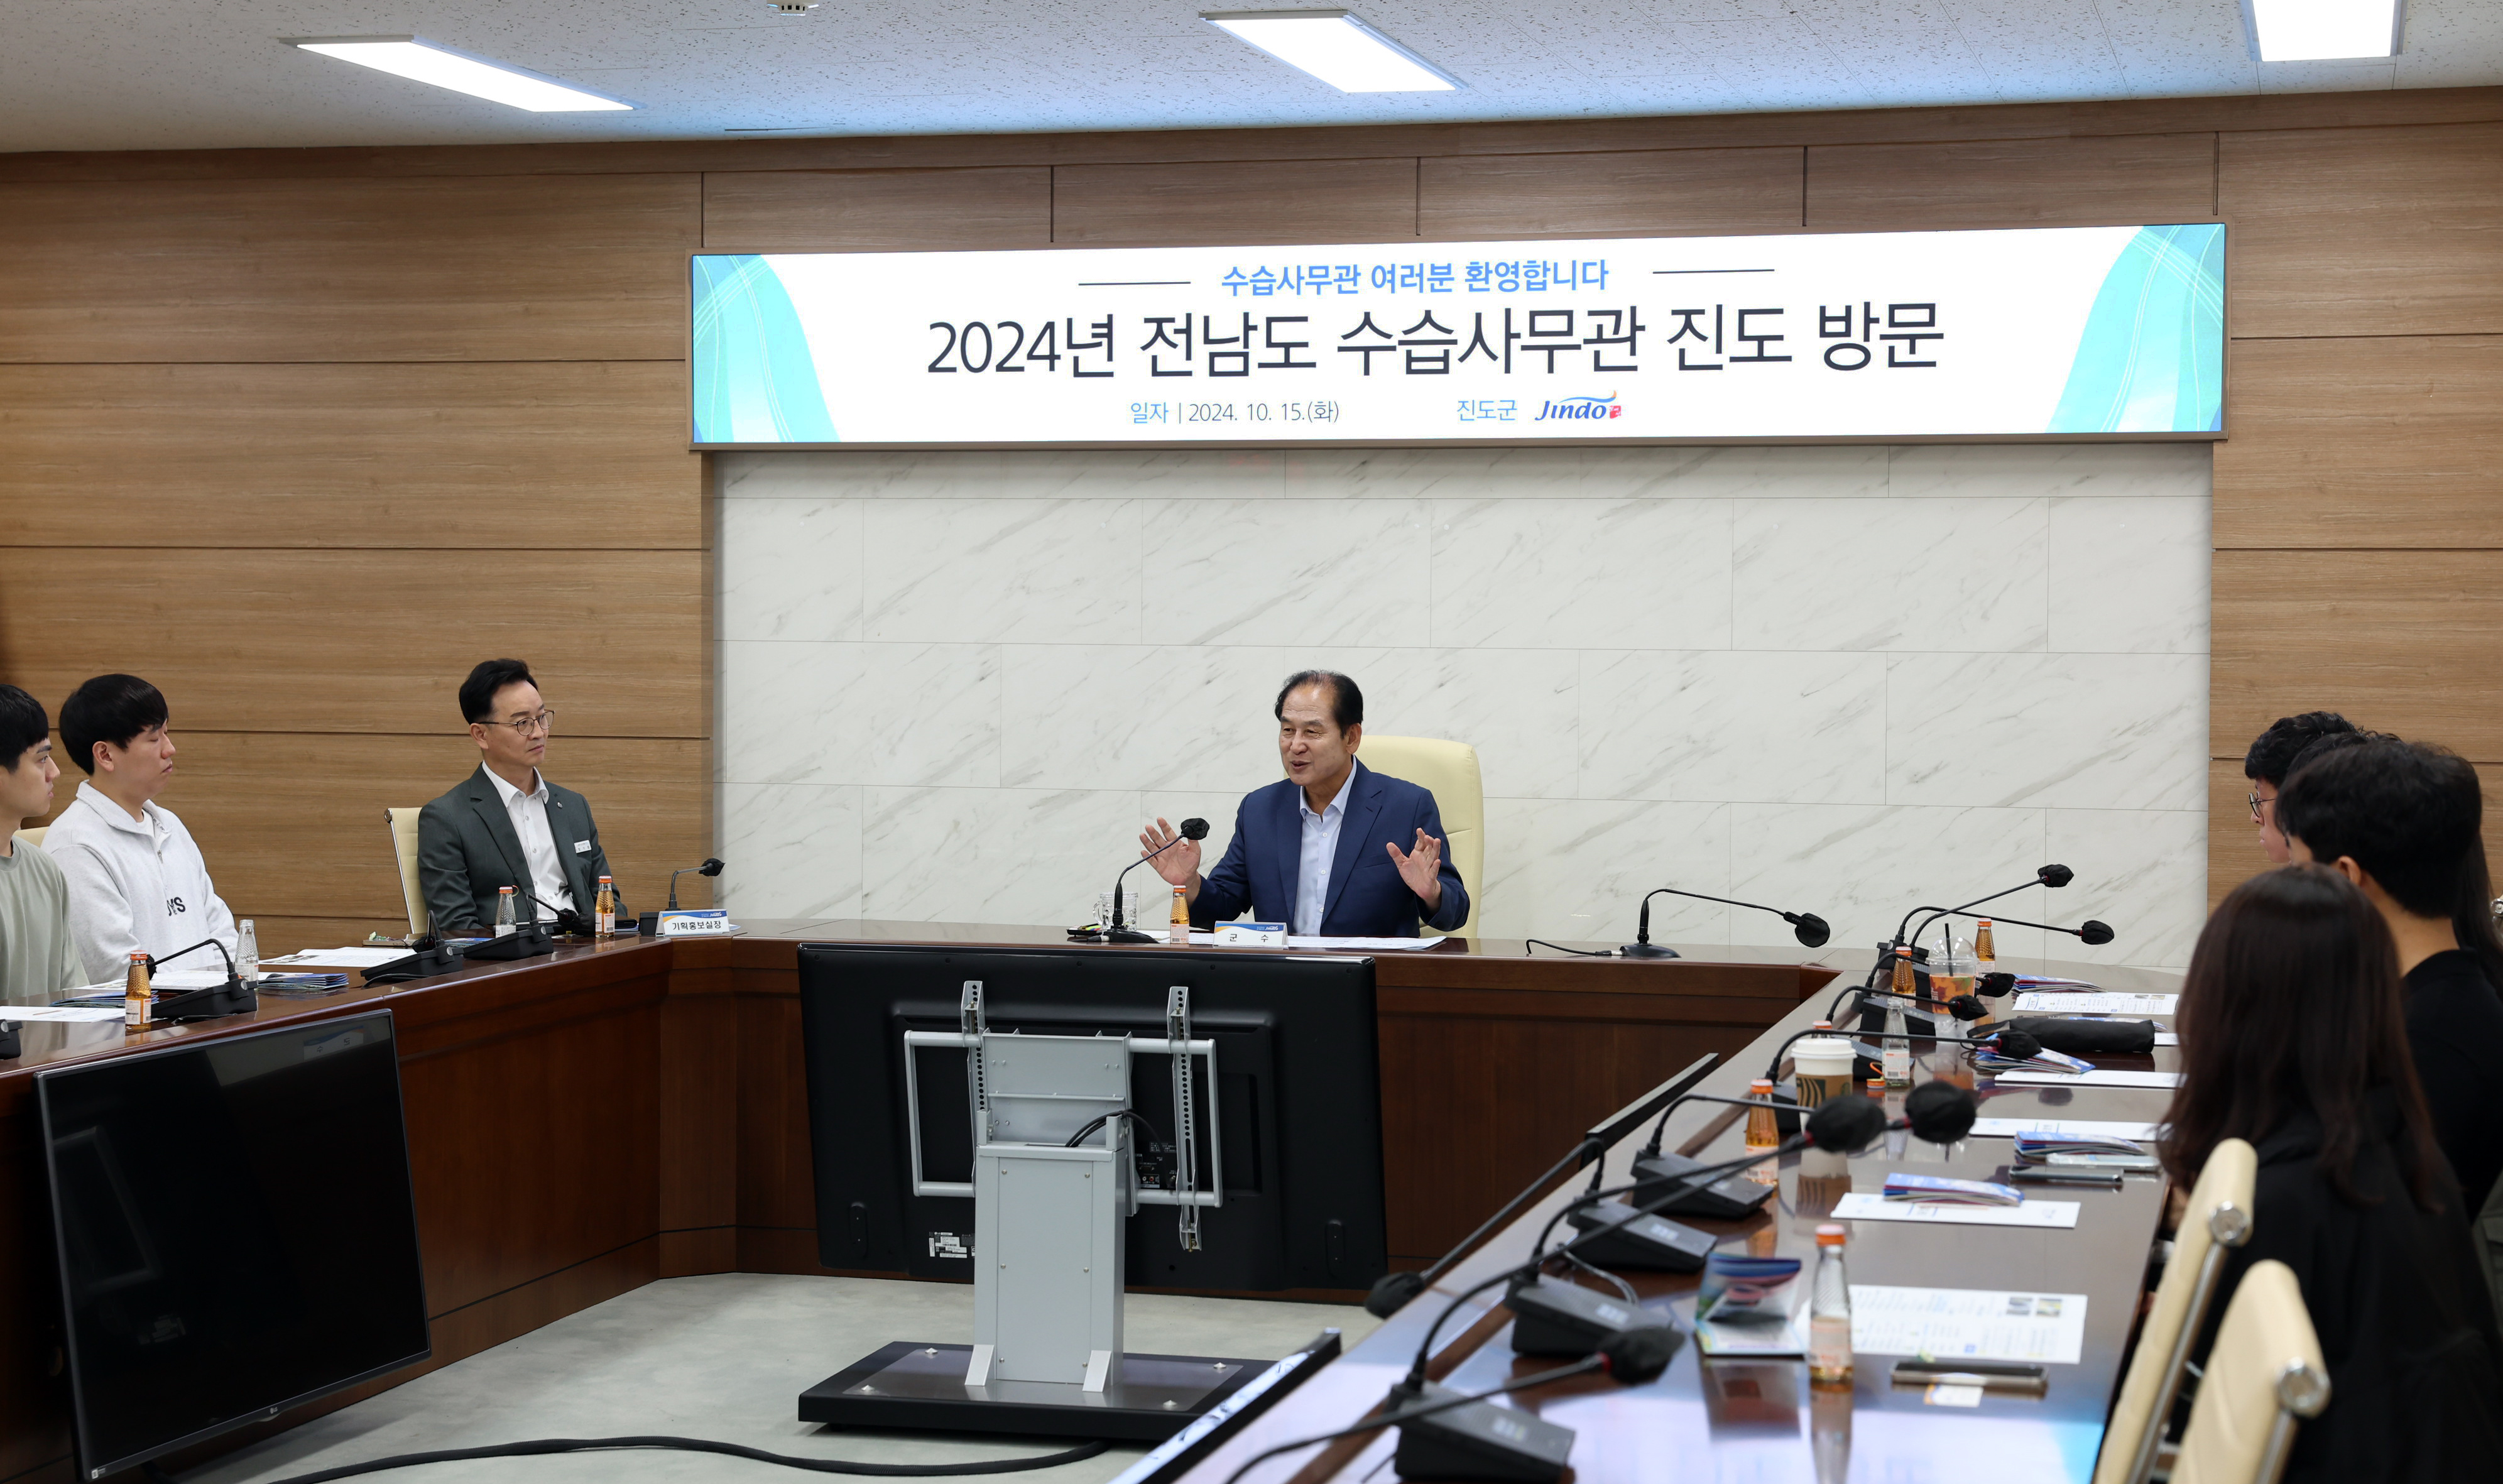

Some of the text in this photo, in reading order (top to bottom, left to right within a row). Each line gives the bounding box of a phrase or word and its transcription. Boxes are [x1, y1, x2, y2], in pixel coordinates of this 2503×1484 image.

[1222, 259, 1610, 297] 수습사무관 여러분 환영합니다
[928, 302, 1945, 379] 2024년 전남도 수습사무관 진도 방문
[1130, 401, 1339, 424] 일자 2024. 10. 15.(화)
[1458, 400, 1518, 422] 진도군
[1534, 400, 1607, 421] Jindo
[672, 920, 722, 930] 기획홍보실장
[1230, 934, 1268, 942] 군 수
